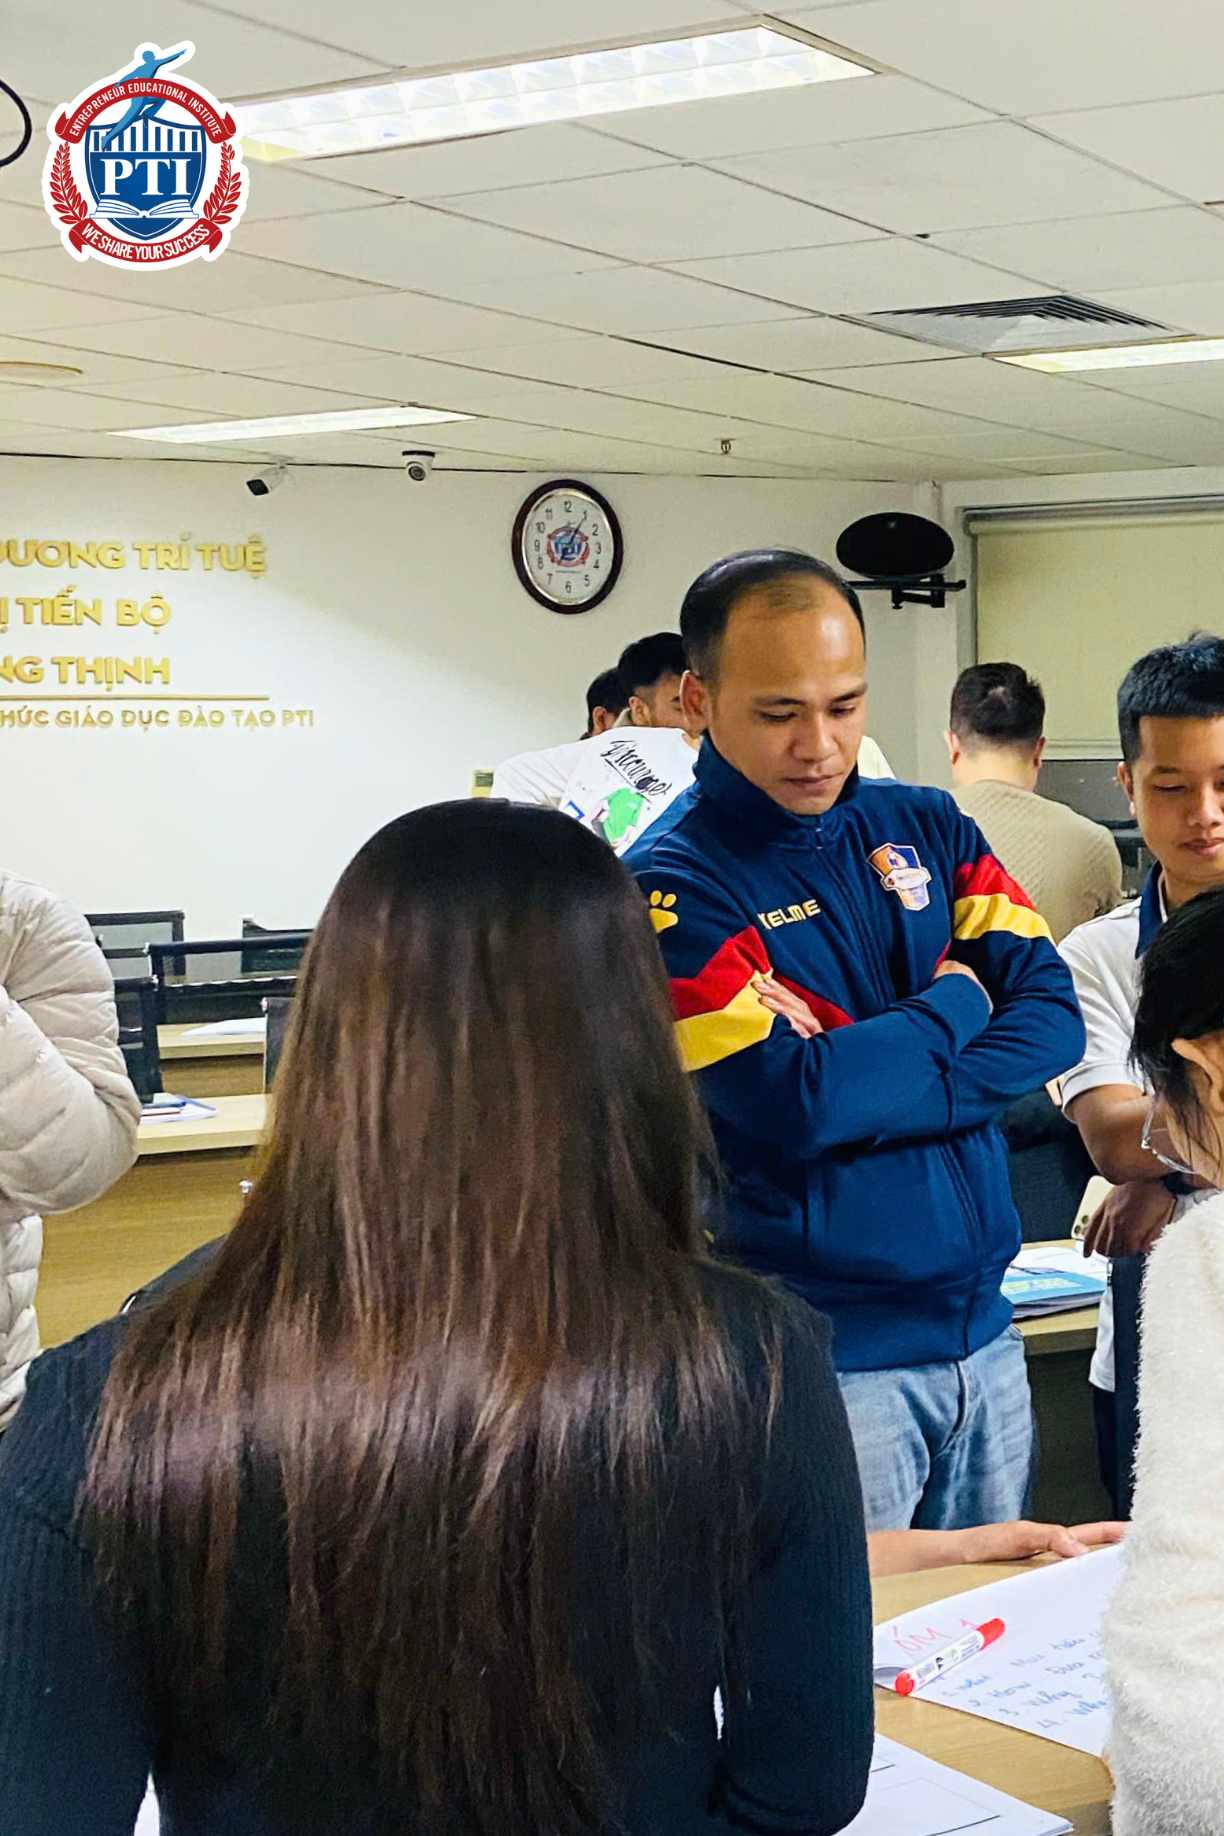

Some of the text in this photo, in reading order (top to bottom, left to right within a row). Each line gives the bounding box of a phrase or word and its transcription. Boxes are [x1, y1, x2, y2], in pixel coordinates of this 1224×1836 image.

[133, 532, 191, 570] TRÍ
[196, 532, 267, 579] TUỆ
[16, 585, 102, 626] TIẾN
[116, 593, 171, 634] BỘ
[51, 656, 170, 691] THỊNH
[56, 704, 113, 728] GIÁO
[121, 709, 170, 731] DỤC
[232, 709, 275, 731] TẠO
[282, 709, 315, 728] PTI
